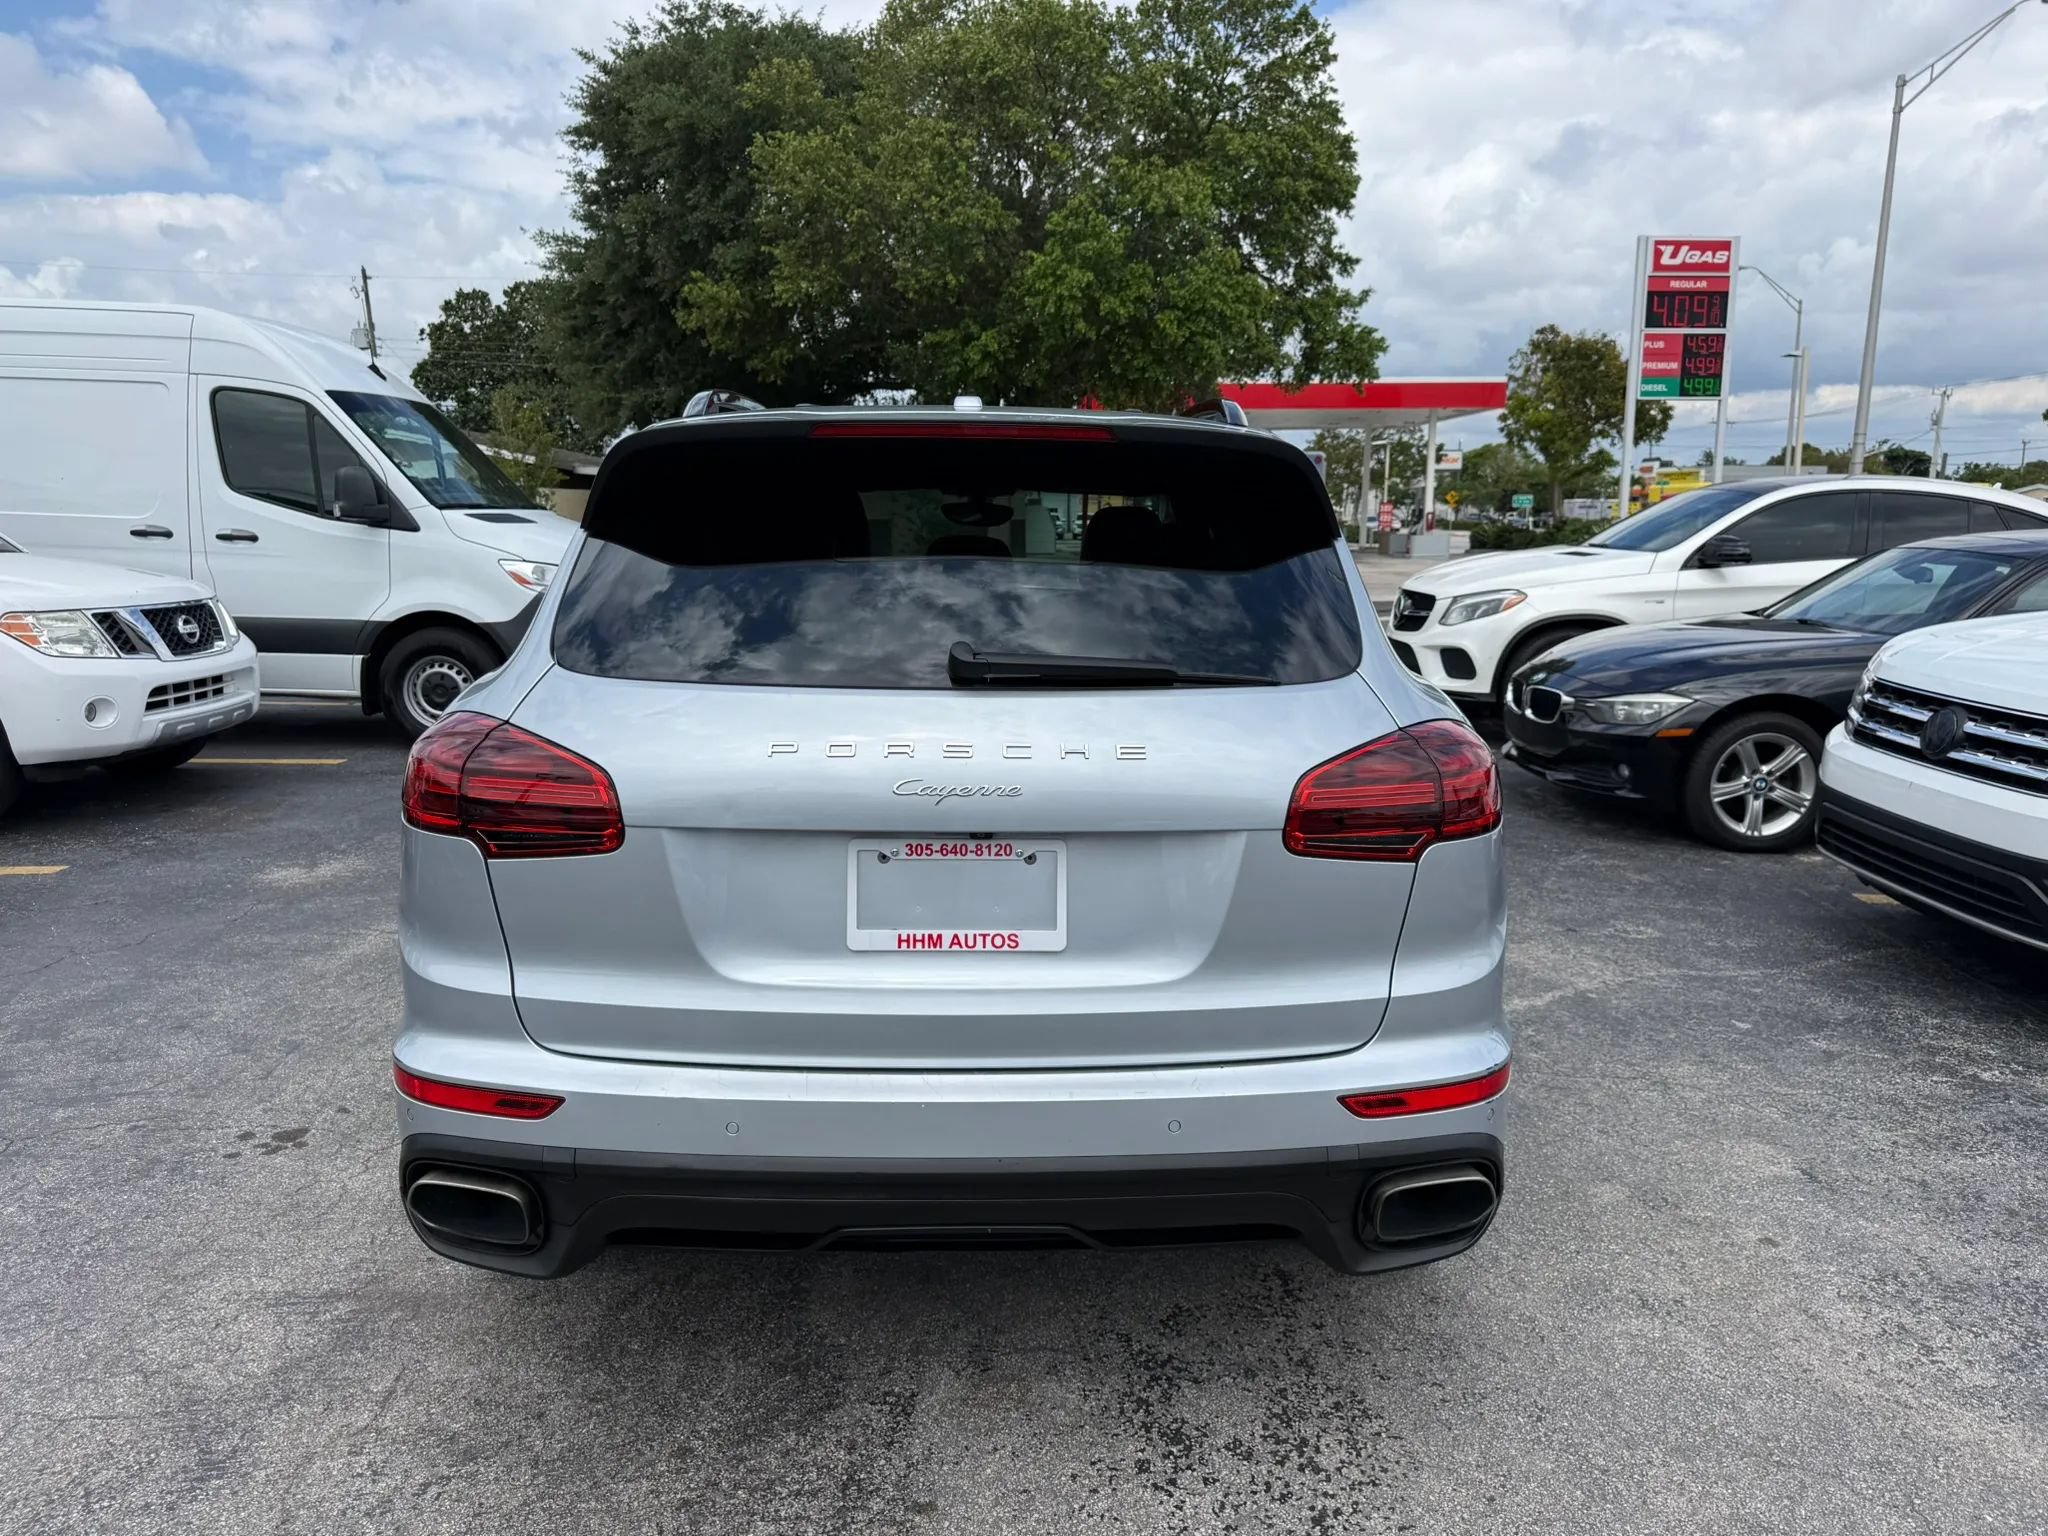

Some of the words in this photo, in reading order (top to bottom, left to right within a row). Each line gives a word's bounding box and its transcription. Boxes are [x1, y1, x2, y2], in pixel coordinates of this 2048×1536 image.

[1656, 244, 1730, 265] UGAS
[1669, 280, 1707, 289] REGULAR
[1644, 340, 1665, 349] PLUS
[1642, 361, 1678, 370] PREMIUM
[1640, 383, 1668, 392] DIESEL
[767, 741, 1148, 760] PORSCHE
[892, 777, 1024, 806] Cayenne
[904, 843, 1013, 857] 305-640-8120
[897, 933, 943, 949] HHM
[949, 933, 1020, 950] AUTOS
